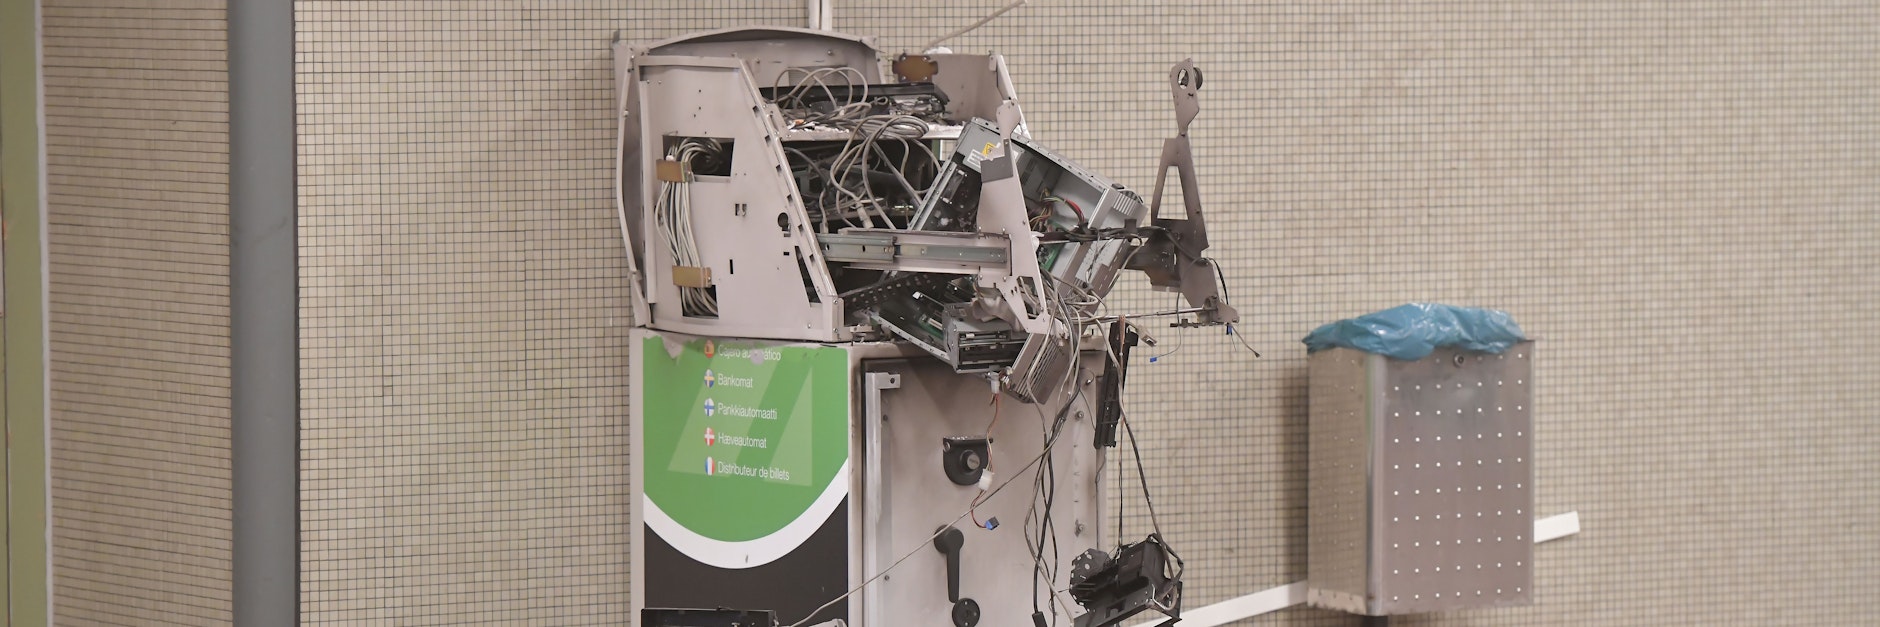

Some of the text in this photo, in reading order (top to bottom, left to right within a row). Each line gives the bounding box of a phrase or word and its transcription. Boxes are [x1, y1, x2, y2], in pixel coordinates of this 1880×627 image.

[717, 373, 753, 388] Bankomat
[717, 402, 777, 420] Pankkiautomaatti
[717, 432, 767, 449] Hæveautomat
[717, 460, 790, 481] Distributeur de billets
